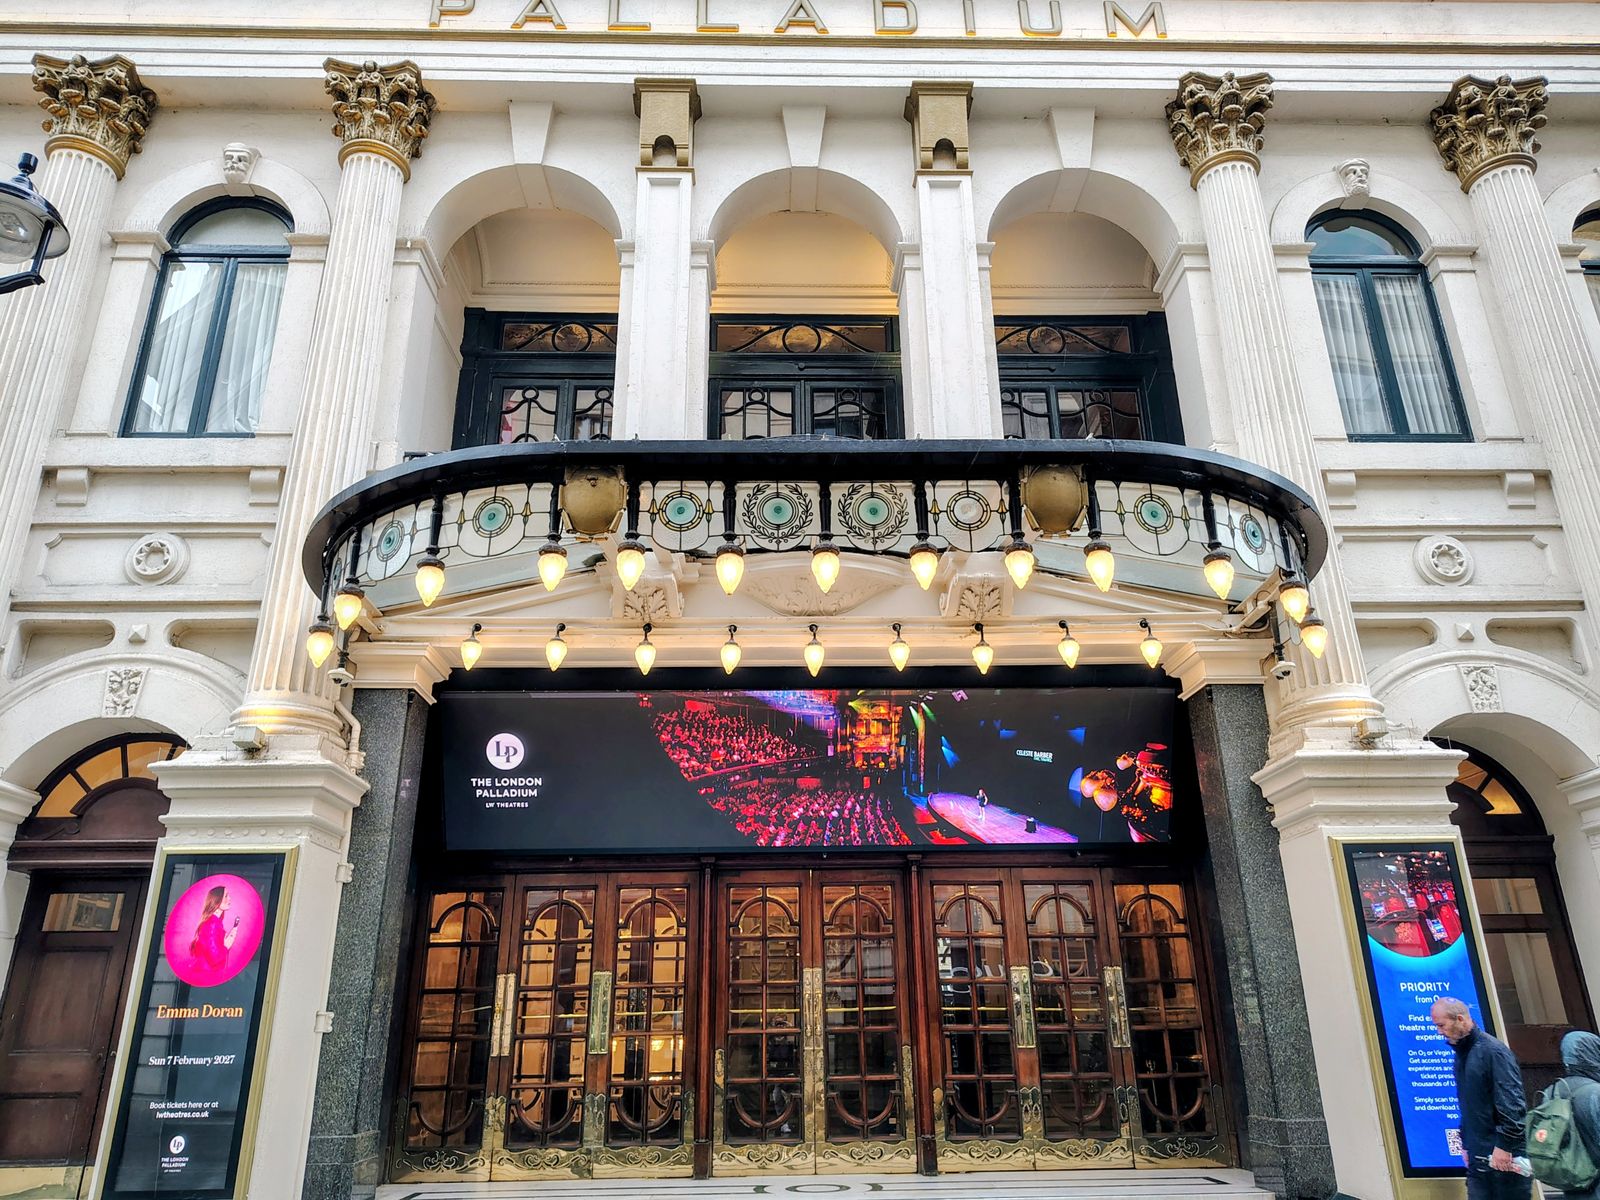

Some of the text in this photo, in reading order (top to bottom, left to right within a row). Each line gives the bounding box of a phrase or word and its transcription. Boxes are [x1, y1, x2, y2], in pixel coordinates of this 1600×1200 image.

[429, 0, 1167, 38] PALLADIUM
[470, 777, 542, 787] THE LONDON
[476, 788, 538, 798] PALLADIUM
[1400, 982, 1450, 992] PRIORITY
[1415, 995, 1433, 1003] from
[156, 1003, 243, 1019] Emma Doran
[1408, 1014, 1424, 1022] Find
[1399, 1023, 1426, 1031] theatre
[1415, 1033, 1448, 1042] experien
[148, 1054, 236, 1067] Sun 7 February 2027
[1414, 1096, 1433, 1104] Simply
[149, 1101, 166, 1109] Book
[167, 1101, 187, 1109] tickets
[188, 1101, 203, 1109] here
[211, 1101, 219, 1109] at
[156, 1110, 209, 1119] lwtheatres.co.uk
